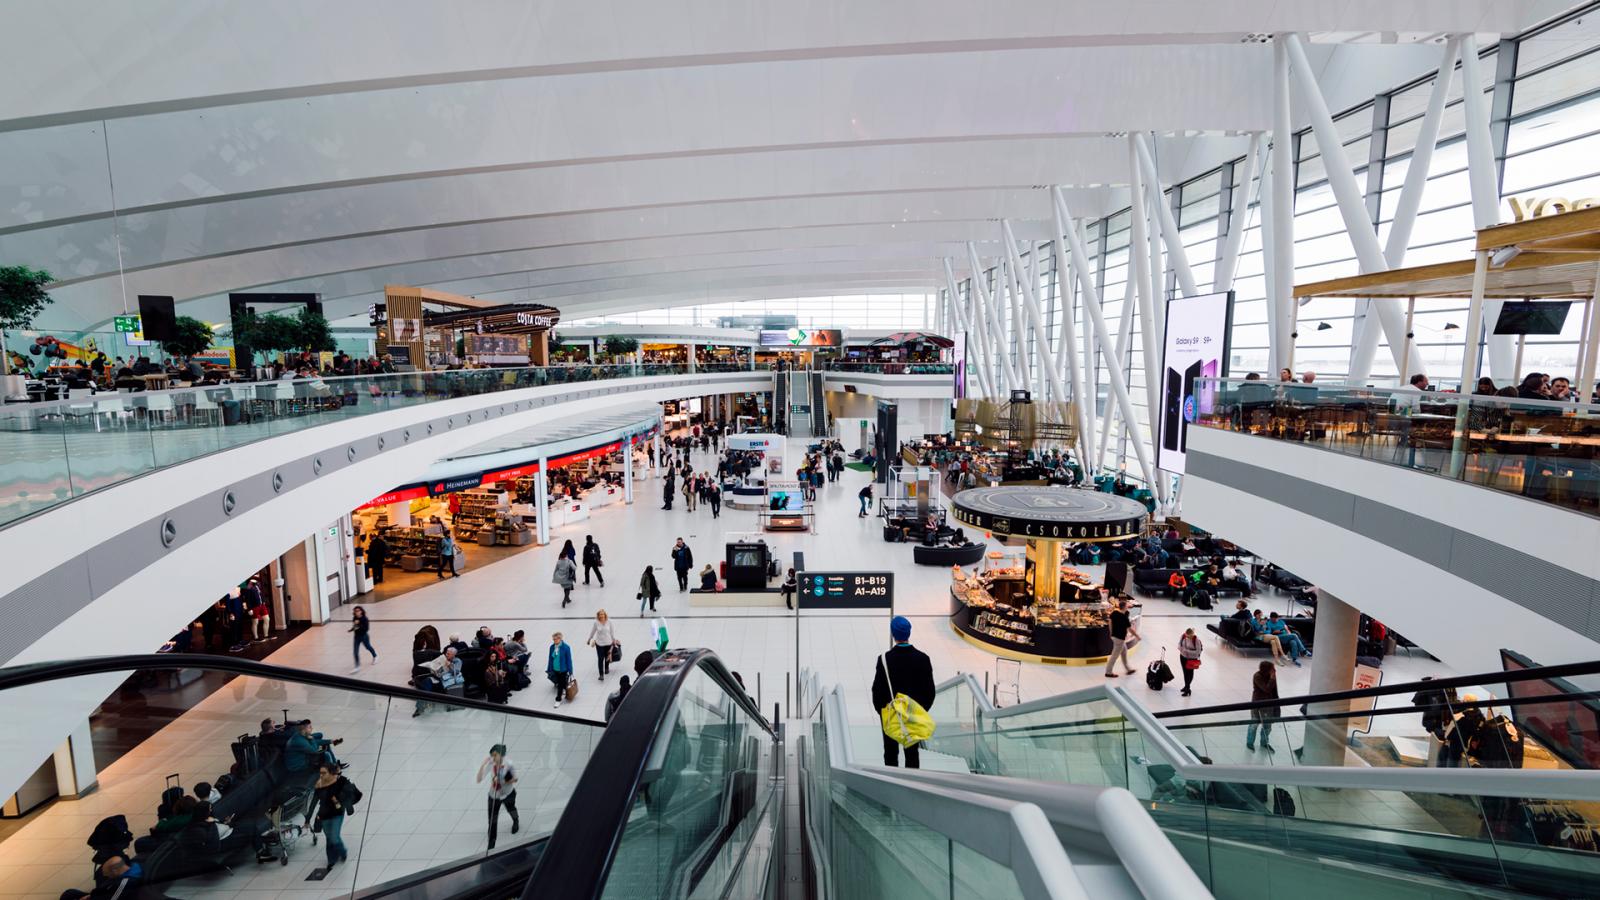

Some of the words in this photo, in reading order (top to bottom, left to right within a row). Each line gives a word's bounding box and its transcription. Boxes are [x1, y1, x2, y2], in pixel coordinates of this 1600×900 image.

[517, 312, 533, 325] COSTA
[534, 315, 552, 327] COFFEE
[1176, 337, 1192, 346] Galaxy
[1192, 336, 1199, 345] S9
[446, 479, 480, 490] HEINEMANN
[376, 495, 397, 505] VALUE
[1026, 521, 1133, 537] CSOKOLÁDÉ
